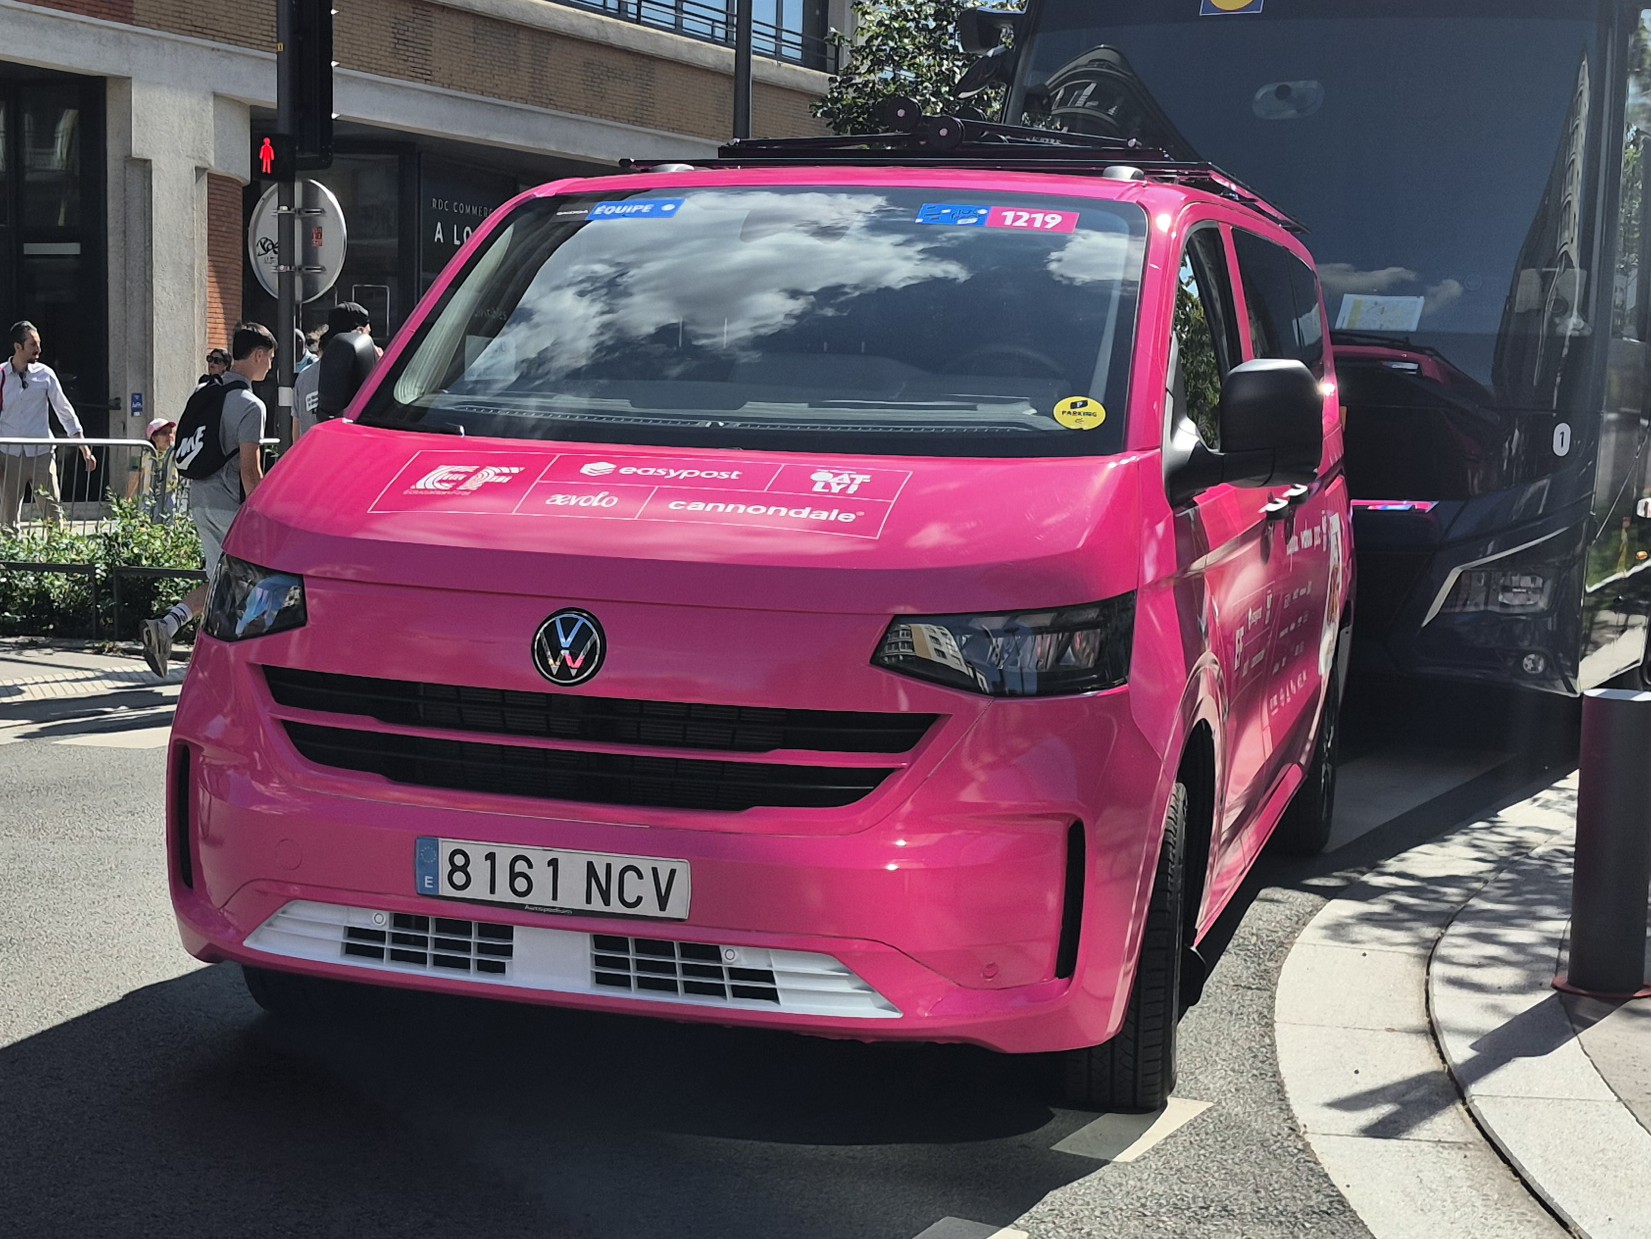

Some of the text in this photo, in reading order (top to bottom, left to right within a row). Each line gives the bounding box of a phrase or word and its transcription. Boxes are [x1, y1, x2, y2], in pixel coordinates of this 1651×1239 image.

[432, 198, 449, 212] RDC
[1001, 210, 1062, 229] 1219
[434, 221, 444, 243] A
[1559, 431, 1565, 448] 1
[410, 465, 525, 490] EF
[619, 466, 743, 479] easypost
[668, 500, 857, 523] cannondale
[424, 848, 677, 912] E 8161 NCV
